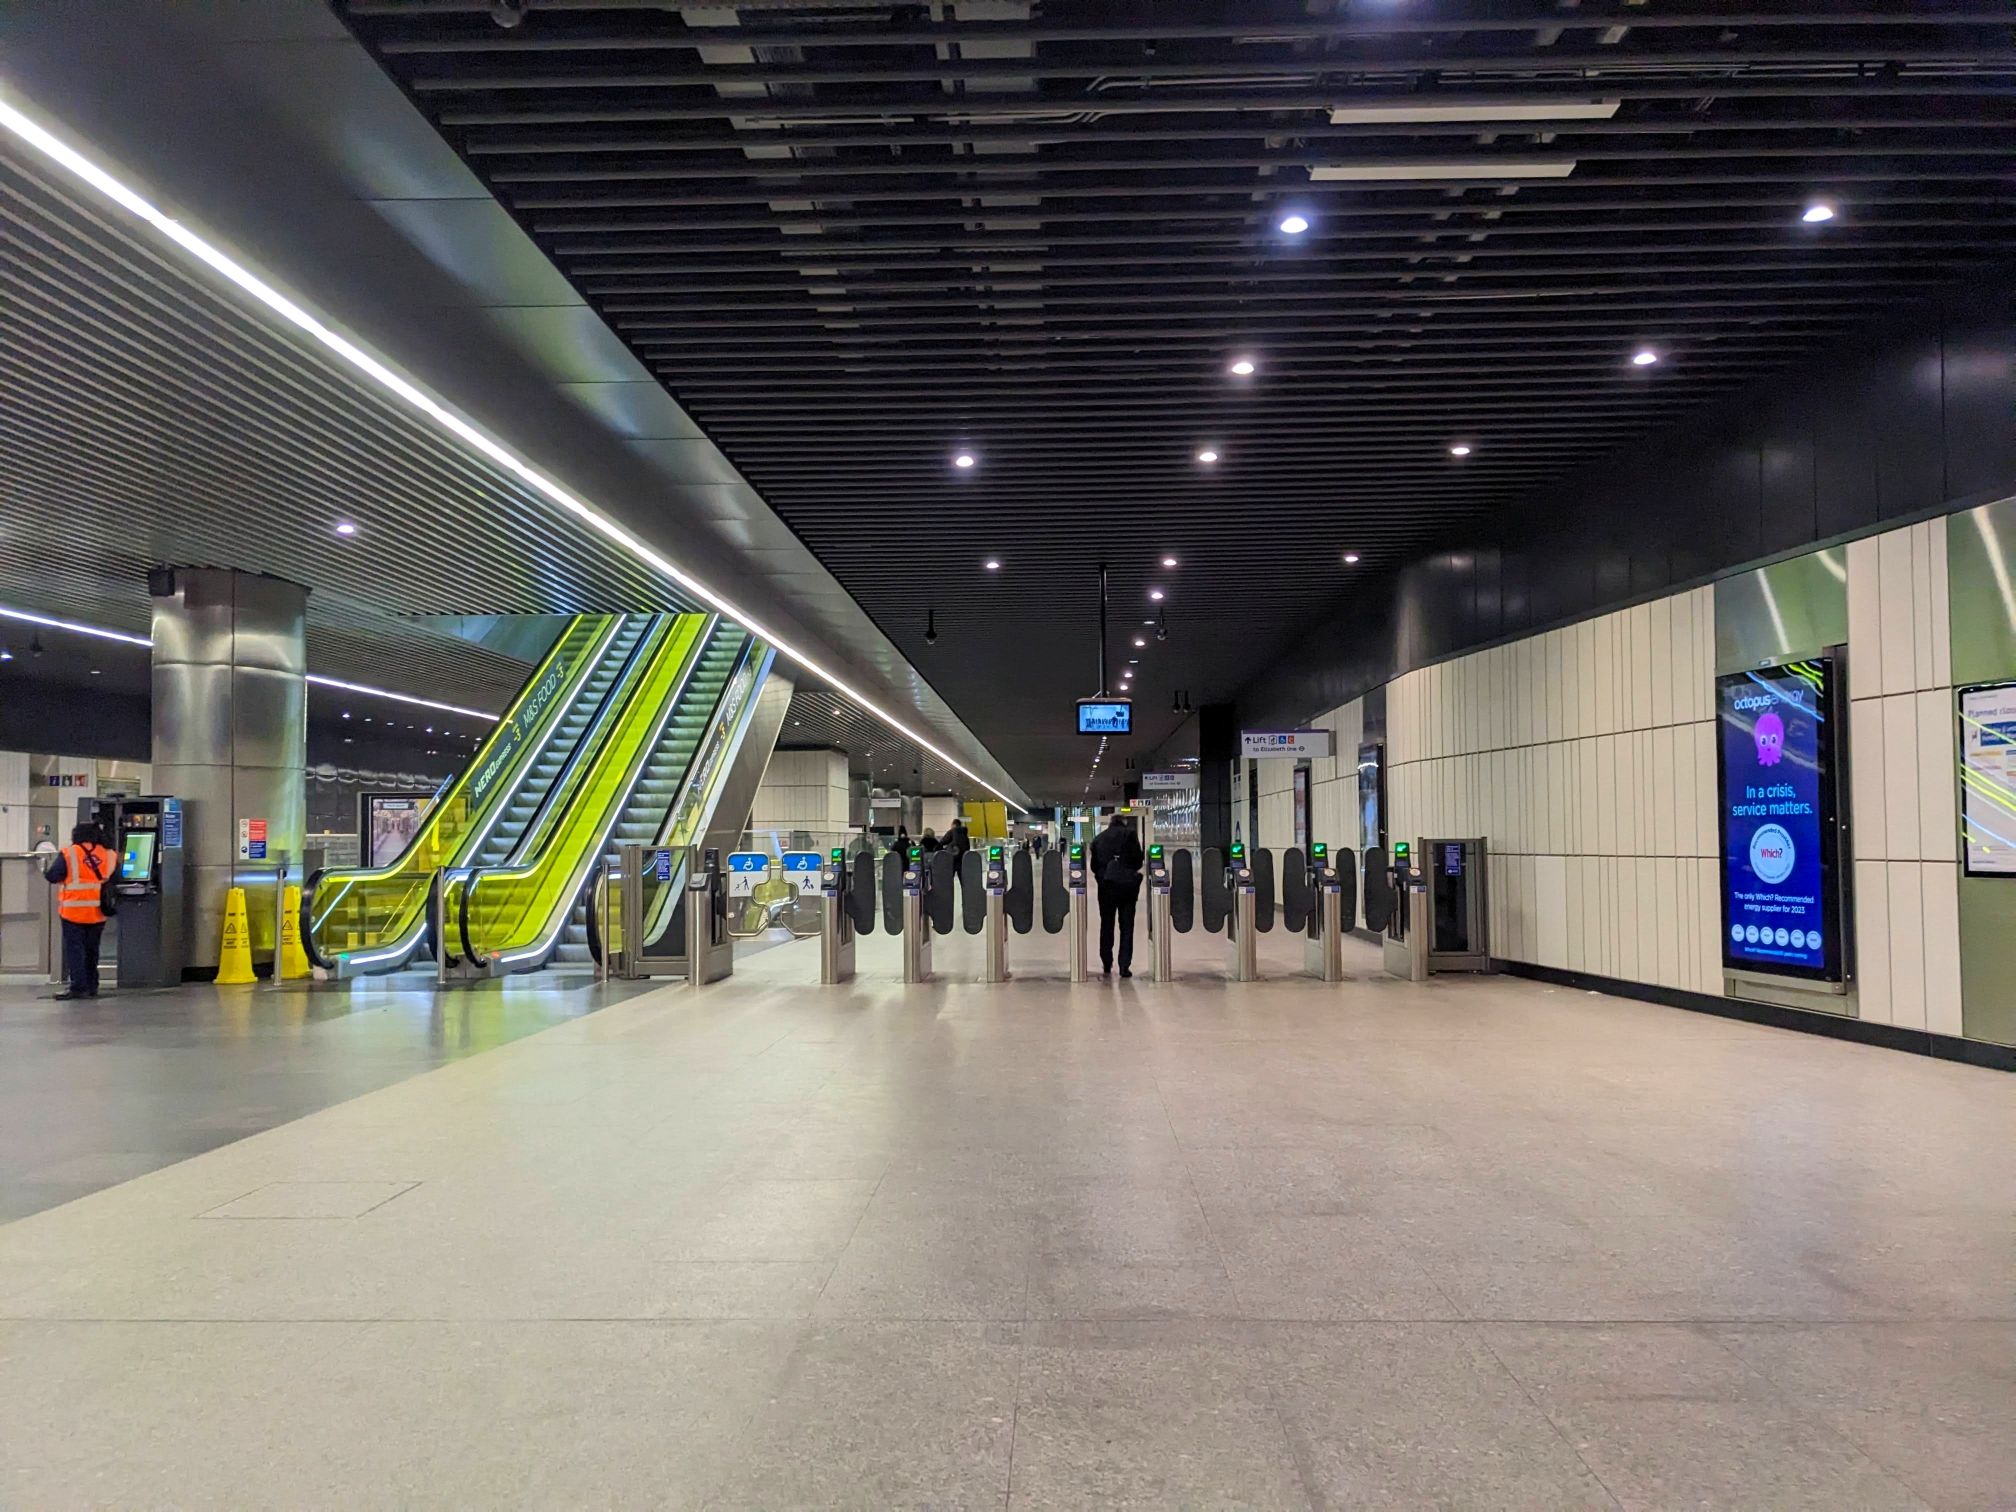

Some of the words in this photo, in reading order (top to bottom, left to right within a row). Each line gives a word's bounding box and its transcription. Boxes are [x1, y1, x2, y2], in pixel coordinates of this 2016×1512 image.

[522, 699, 538, 728] M&S
[536, 674, 557, 708] FOOD
[1252, 736, 1267, 744] Lift
[474, 761, 496, 798] NERO
[1746, 785, 1756, 799] In
[1758, 787, 1765, 798] a
[1767, 783, 1796, 799] crisis,
[1732, 802, 1767, 816] service
[1769, 801, 1813, 815] matters.
[1761, 848, 1783, 858] Which?
[1734, 891, 1744, 899] The
[1744, 892, 1755, 902] only
[1755, 893, 1774, 902] Which?
[1774, 894, 1815, 904] Recommended
[1744, 904, 1761, 912] energy
[1762, 905, 1781, 913] supplier
[1782, 905, 1790, 913] for
